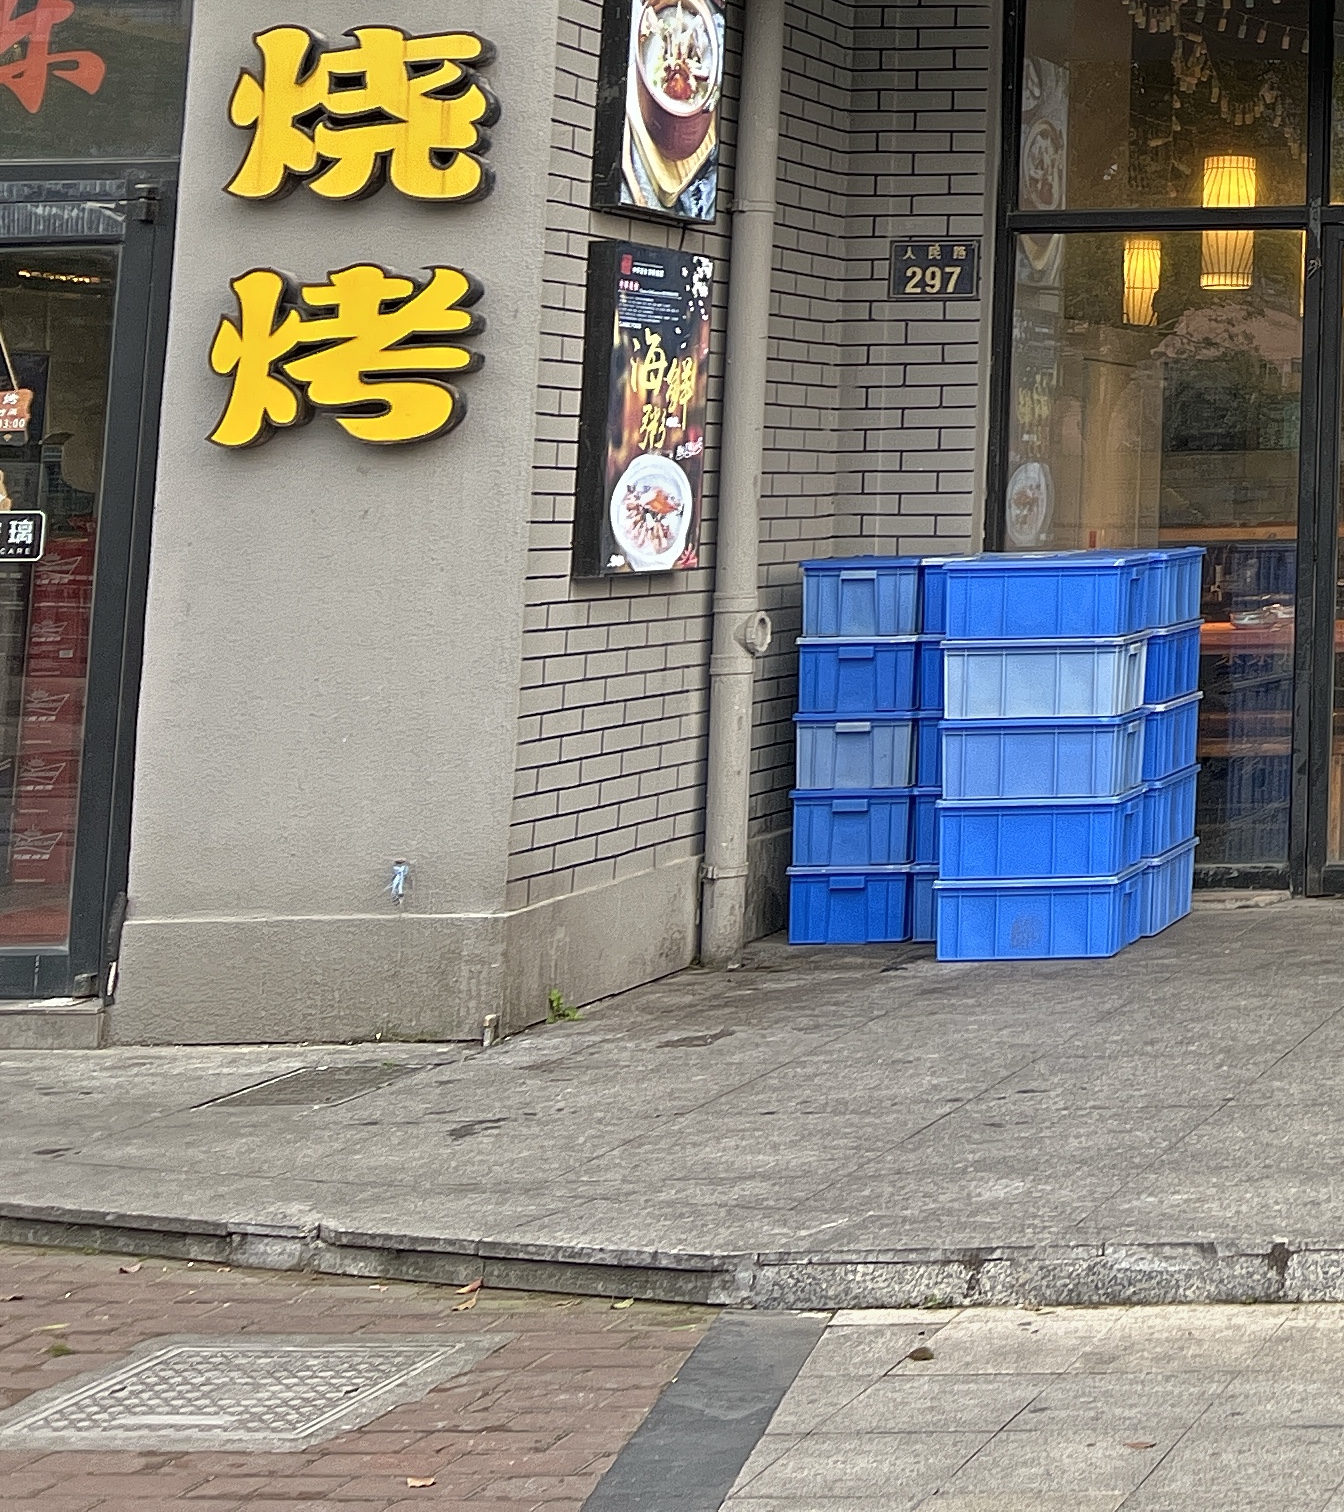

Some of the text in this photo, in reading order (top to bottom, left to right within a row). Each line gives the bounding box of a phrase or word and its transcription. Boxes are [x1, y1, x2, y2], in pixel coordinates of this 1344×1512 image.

[902, 243, 967, 260] 人民路
[904, 266, 962, 293] 297
[0, 518, 34, 544] 璃
